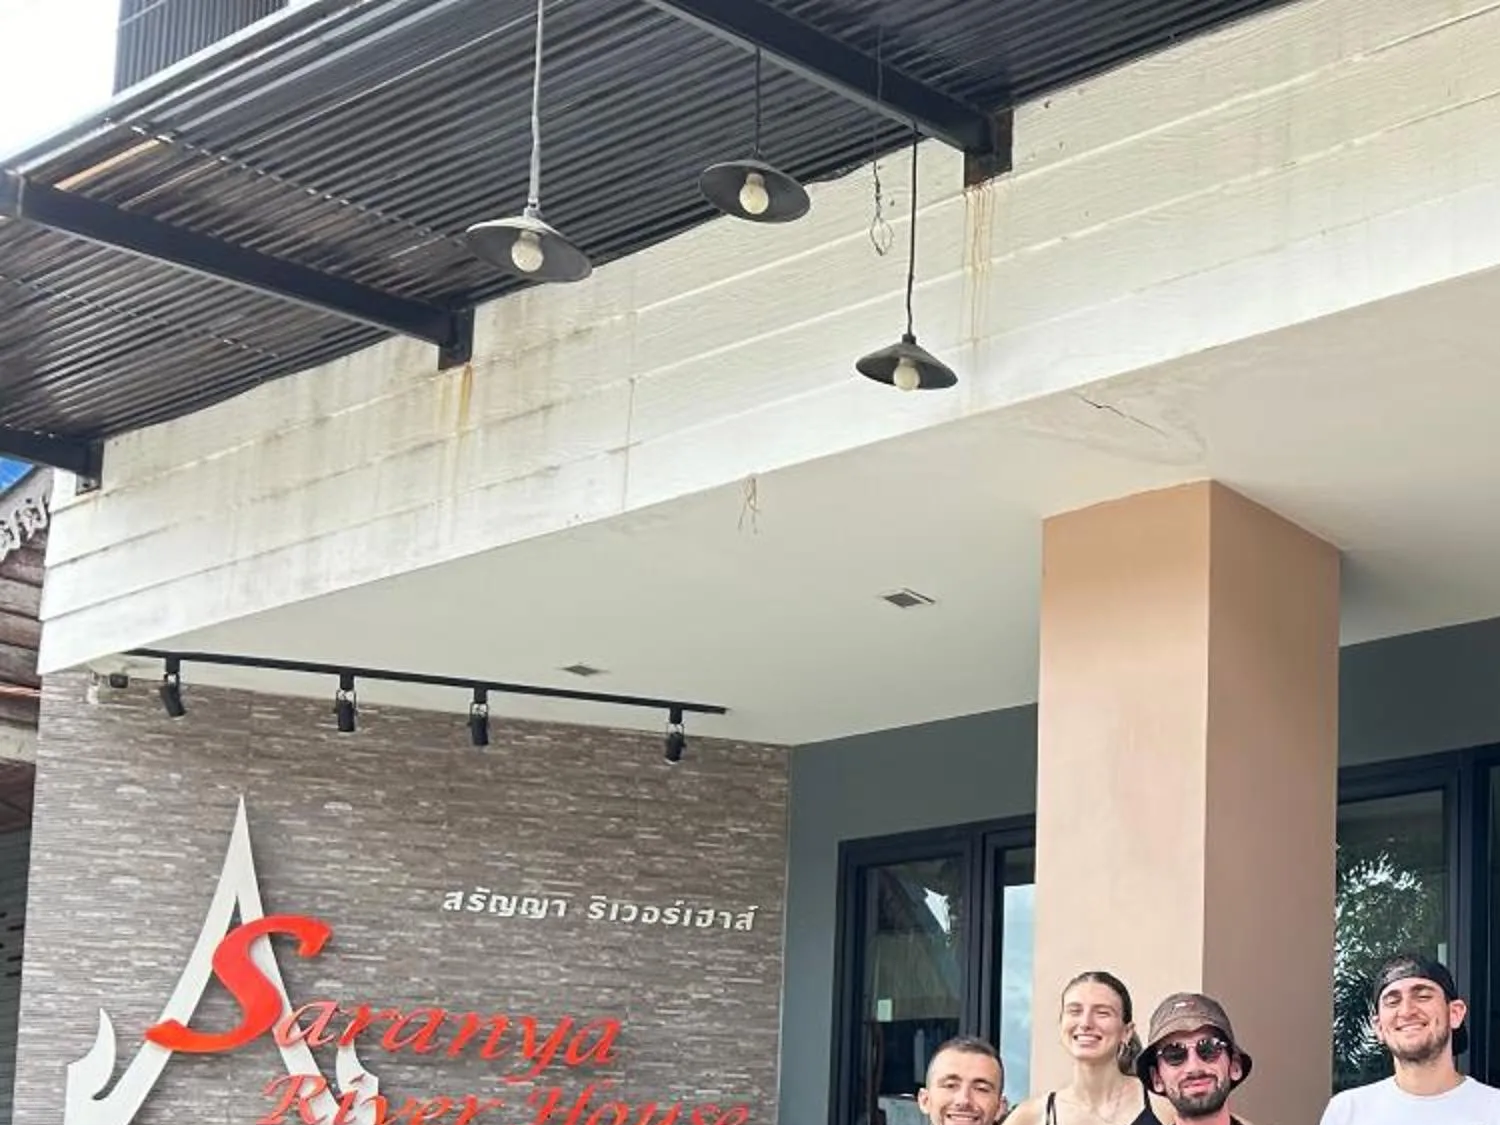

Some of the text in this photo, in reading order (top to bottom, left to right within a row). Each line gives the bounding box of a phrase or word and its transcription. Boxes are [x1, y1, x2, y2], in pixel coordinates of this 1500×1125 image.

[443, 886, 568, 919] สรัญญา
[144, 913, 625, 1084] Saranya
